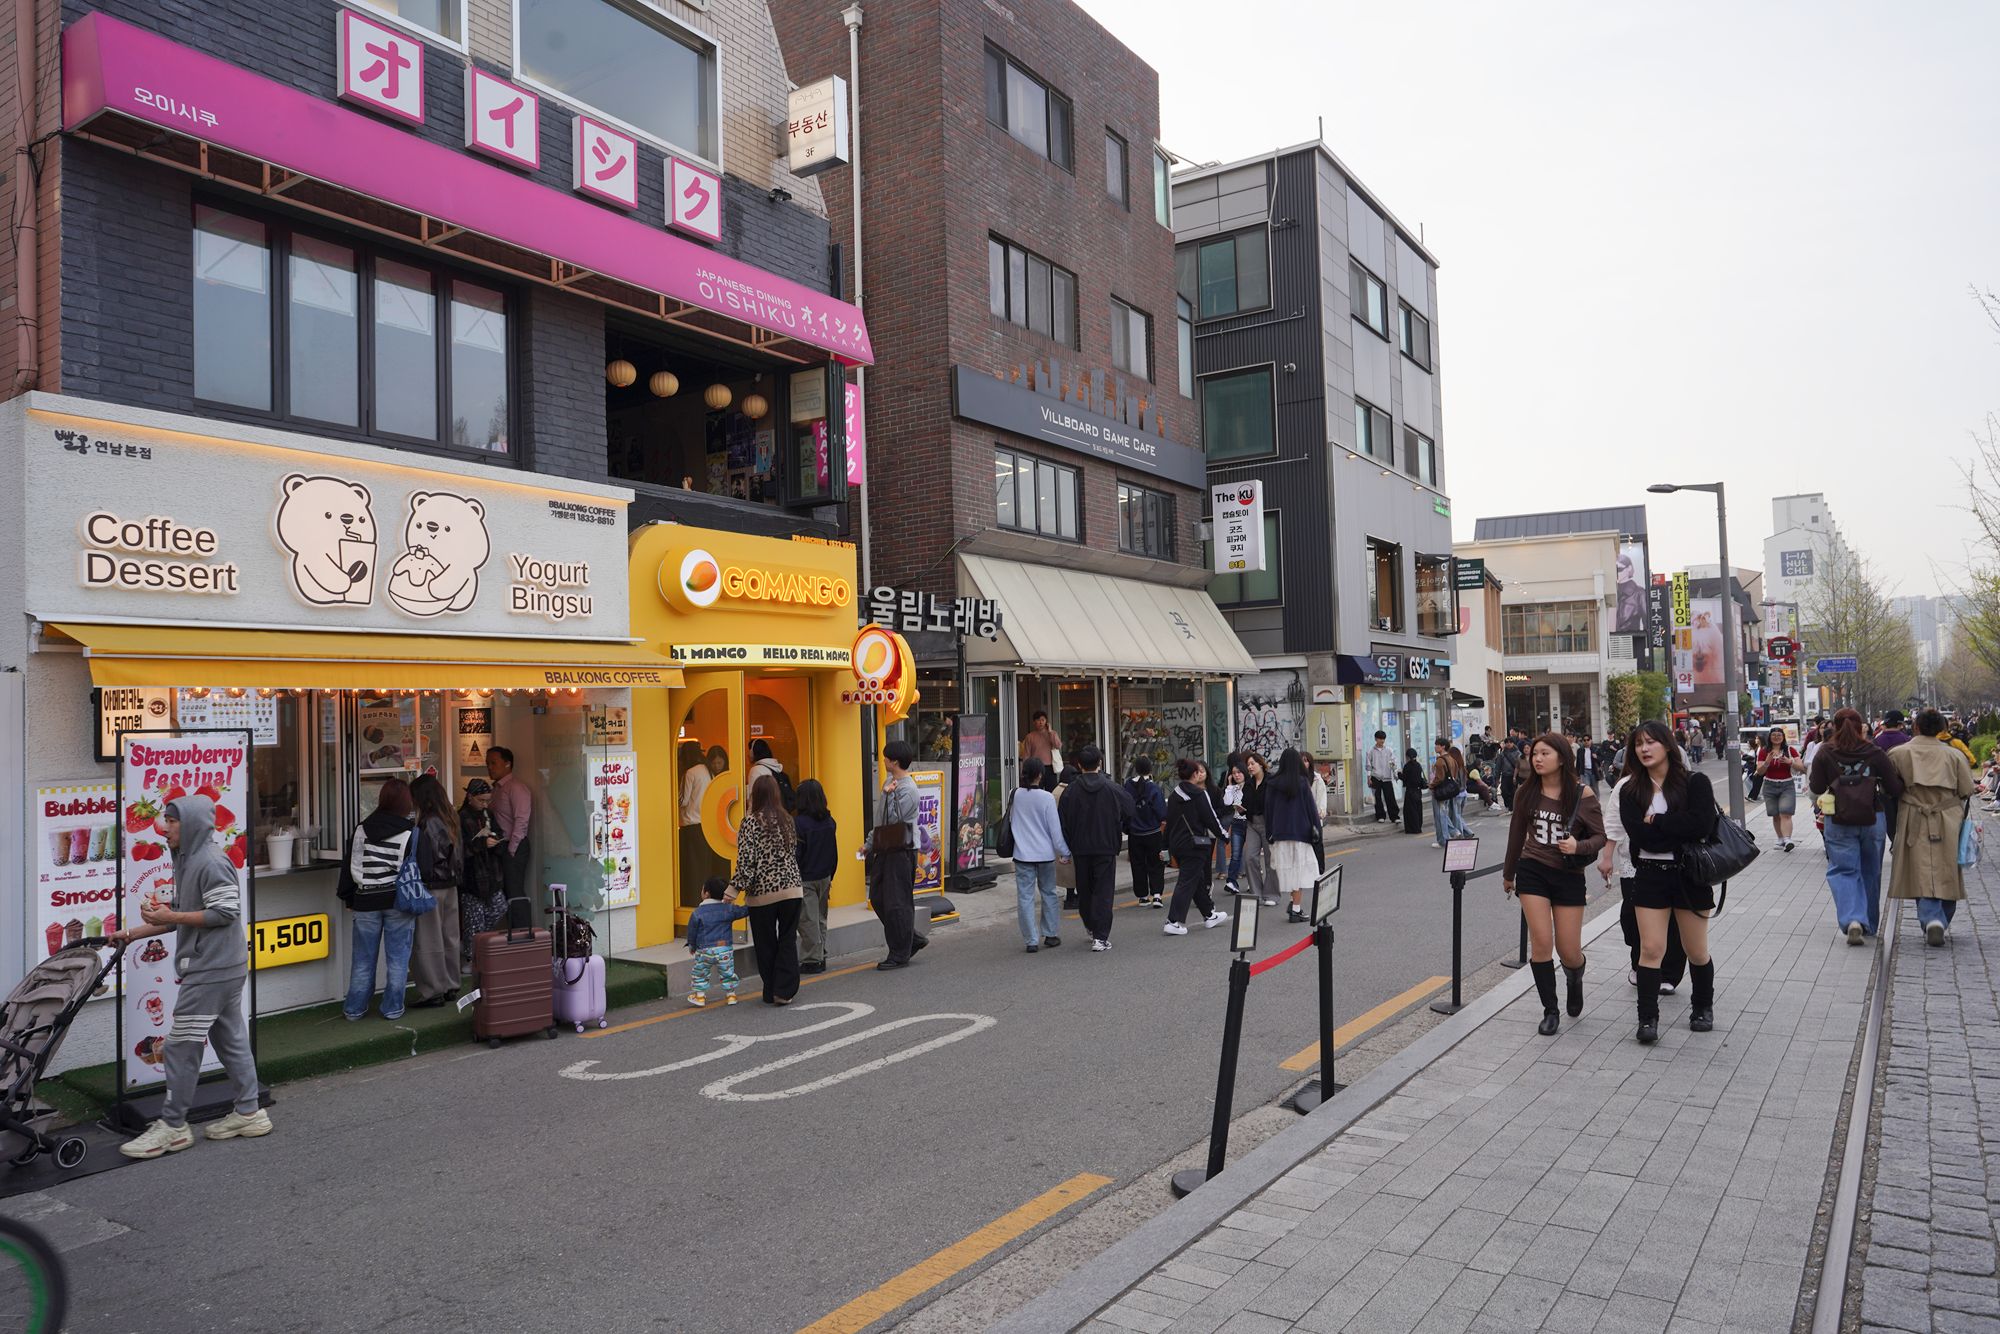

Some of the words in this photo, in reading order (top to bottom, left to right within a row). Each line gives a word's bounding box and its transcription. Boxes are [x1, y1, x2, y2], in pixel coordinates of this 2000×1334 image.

[134, 87, 219, 128] 오이시쿠
[788, 109, 828, 138] 부동산
[805, 147, 815, 158] 3F
[696, 268, 754, 296] JAPANESE
[756, 288, 792, 310] DINING
[699, 281, 796, 328] OISHIKU
[801, 305, 864, 342] オイシク
[803, 325, 867, 354] IZAKAYA
[1215, 493, 1236, 503] The
[1238, 489, 1253, 500] KU
[549, 500, 587, 513] BBALKONG
[588, 506, 616, 518] COFFEE
[577, 513, 615, 526] 1833-8810
[87, 513, 216, 554] Coffee
[1226, 534, 1247, 543] 피규어
[86, 551, 238, 591] Dessert
[512, 554, 590, 586] Yogurt
[1786, 560, 1808, 568] NUL
[723, 566, 851, 608] GOMANGO
[512, 586, 593, 618] Bingsu
[858, 586, 1000, 638] 울림노래방
[1674, 576, 1685, 624] TATTOO
[691, 647, 747, 660] MANGO
[763, 647, 798, 660] HELLO
[800, 648, 825, 661] REAL
[825, 650, 850, 662] MANGO
[1377, 656, 1397, 668] GS
[545, 671, 611, 684] BBALKONG
[613, 671, 661, 684] COFFEE
[1379, 668, 1397, 682] 25
[1409, 655, 1431, 680] GS25
[103, 688, 144, 711] 아메리카노
[842, 691, 896, 703] MANGO
[130, 743, 243, 767] Strawberry
[958, 756, 986, 769] OISHIKU
[143, 766, 233, 790] Festival
[594, 771, 630, 786] BINGSU
[602, 763, 622, 774] CUP
[45, 796, 117, 817] Bubble
[967, 846, 983, 870] 2F
[130, 865, 162, 894] Strawberry
[558, 1001, 997, 1101] 30
